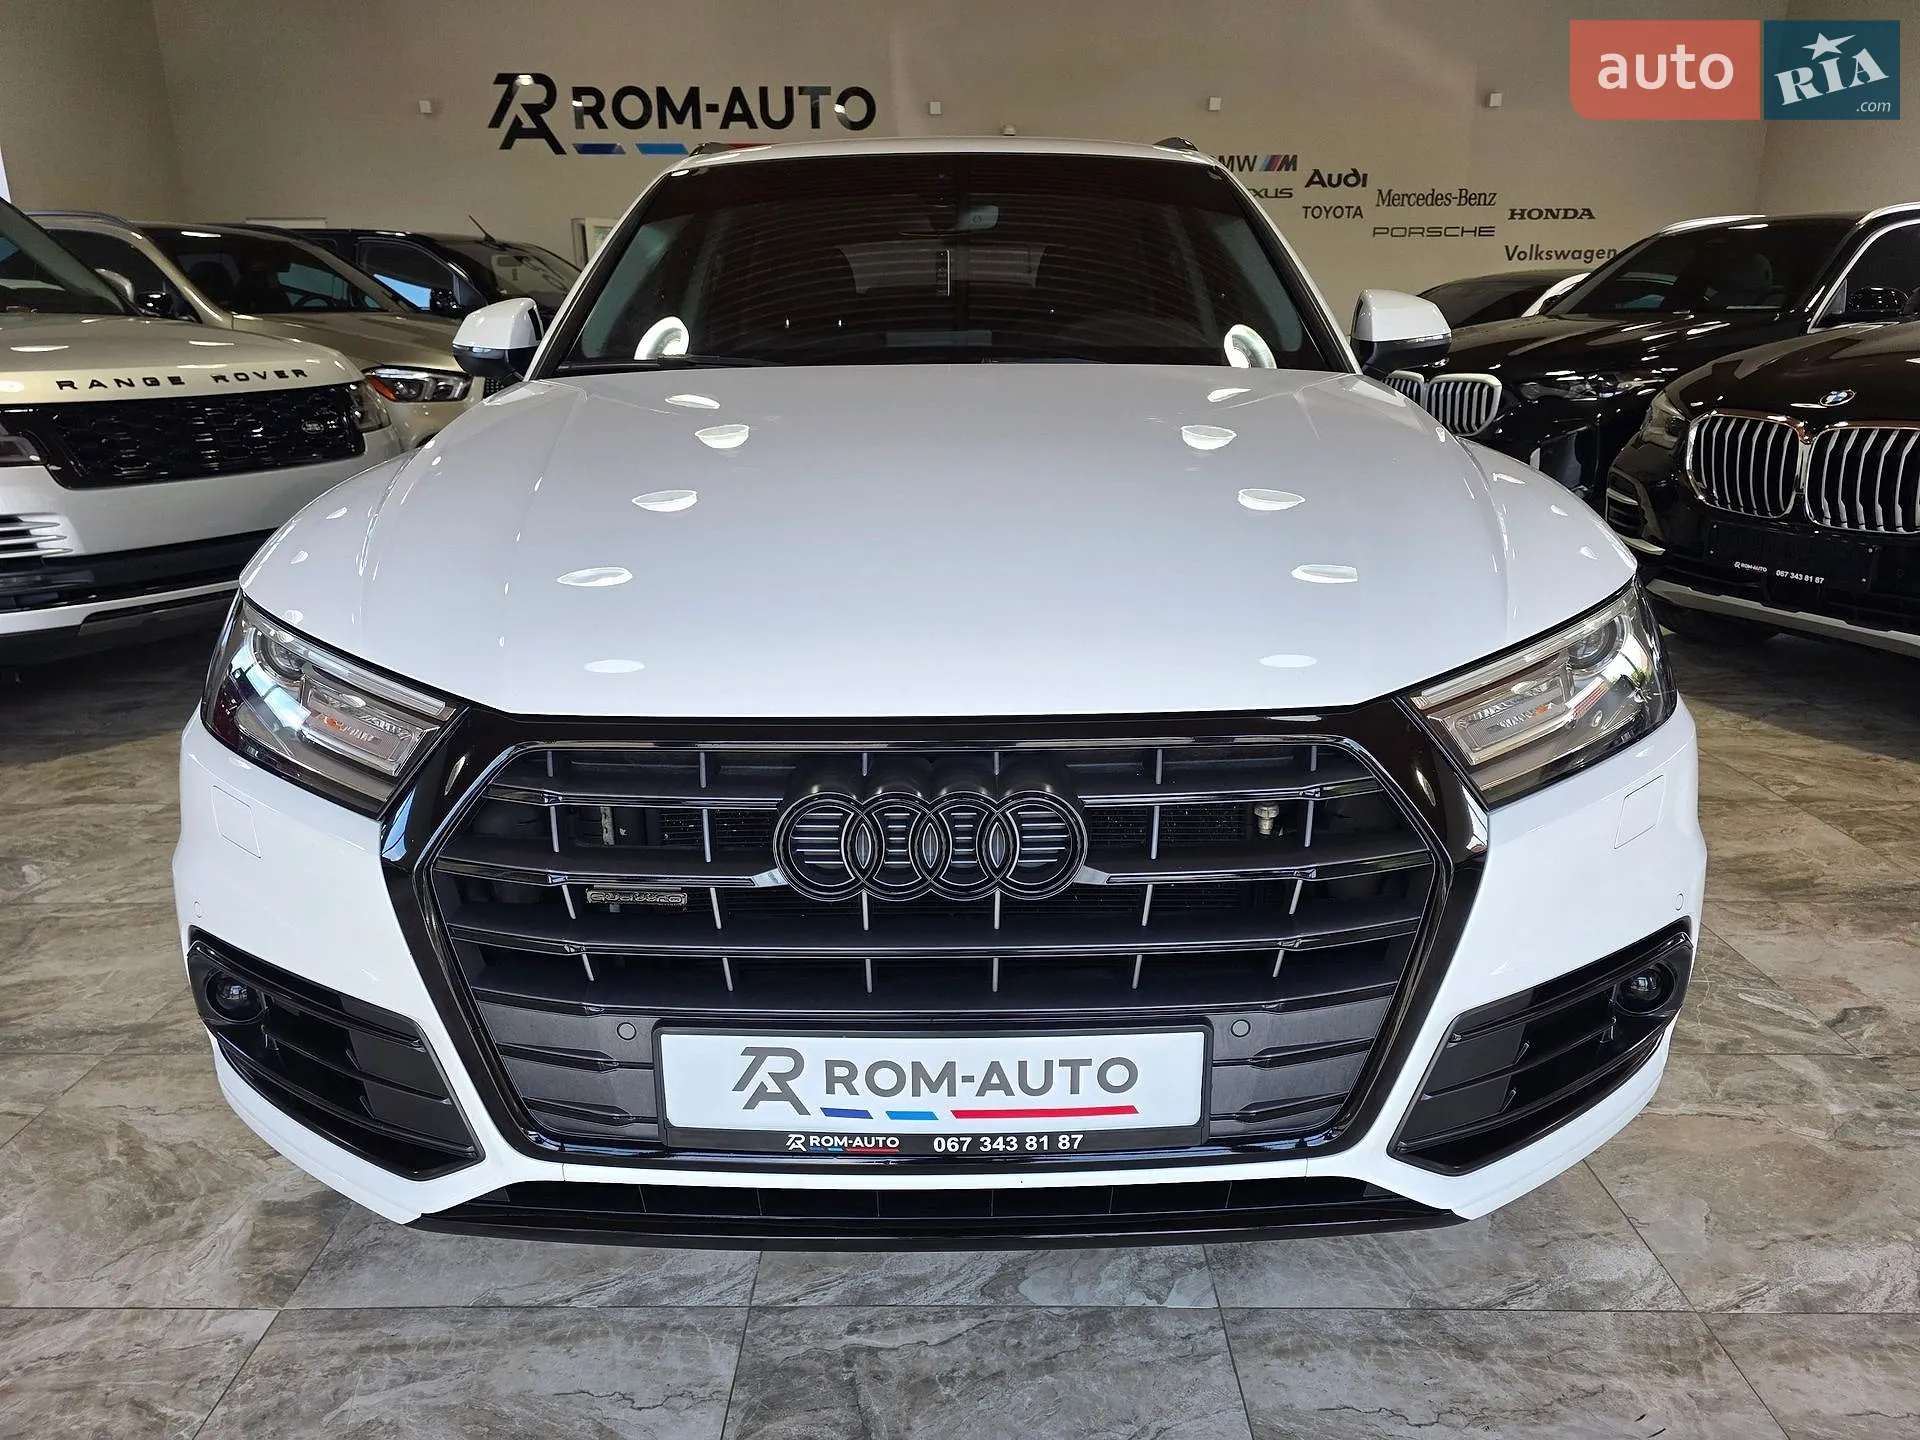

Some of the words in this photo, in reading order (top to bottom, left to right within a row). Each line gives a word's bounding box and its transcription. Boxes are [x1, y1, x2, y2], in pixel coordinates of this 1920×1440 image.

[572, 86, 876, 131] ROM-AUTO
[1217, 155, 1257, 172] MW
[1305, 168, 1368, 188] Audi
[1376, 189, 1497, 207] Mercedes-Benz
[1302, 205, 1363, 219] TOYOTA
[1508, 208, 1596, 220] HONDA
[1372, 226, 1496, 237] PORSCHE
[1504, 244, 1617, 264] Volkswagen
[57, 378, 185, 390] RANGE
[213, 369, 308, 383] ROVER
[1789, 572, 1803, 580] 343
[1804, 574, 1813, 582] 81
[1814, 576, 1825, 584] 87
[825, 1056, 1138, 1097] ROM-AUTO
[808, 1135, 900, 1148] ROM-AUTO
[933, 1136, 970, 1152] 067
[979, 1135, 1018, 1151] 343
[1025, 1135, 1049, 1150] 81
[1057, 1134, 1084, 1150] 87
